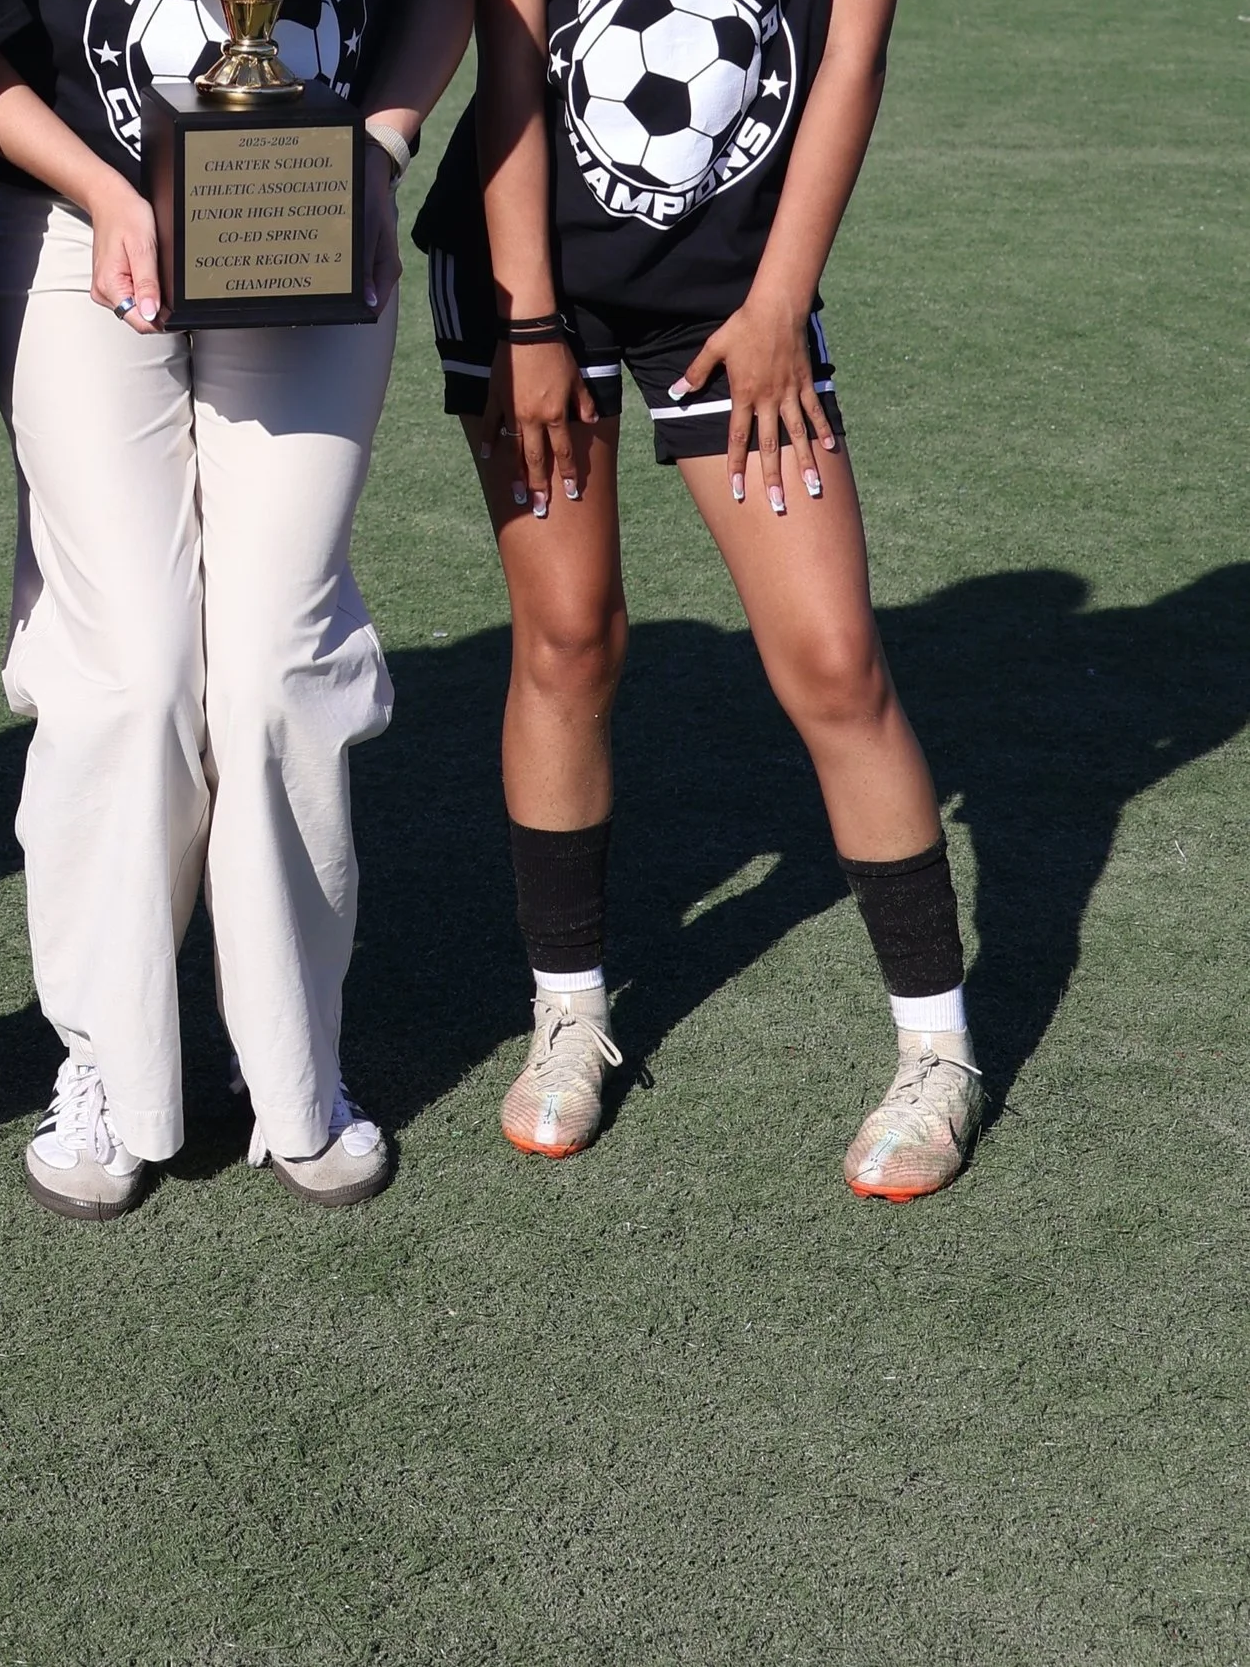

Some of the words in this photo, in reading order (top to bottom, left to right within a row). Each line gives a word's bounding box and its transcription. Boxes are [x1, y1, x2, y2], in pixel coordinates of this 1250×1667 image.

[238, 136, 299, 148] 2025-2026
[204, 159, 270, 172] CHARTER
[274, 157, 333, 170] SCHOOL
[190, 183, 255, 196] ATHLETIC
[258, 180, 348, 195] ASSOCIATION
[191, 208, 243, 222] JUNIOR
[247, 206, 284, 218] HIGH
[288, 204, 346, 217] SCHOOL
[218, 231, 263, 243] CO-ED
[265, 229, 319, 242] SPRING
[195, 255, 251, 268] SOCCER
[255, 253, 310, 266] REGION
[334, 252, 342, 263] 2
[225, 276, 312, 291] CHAMPIONS
